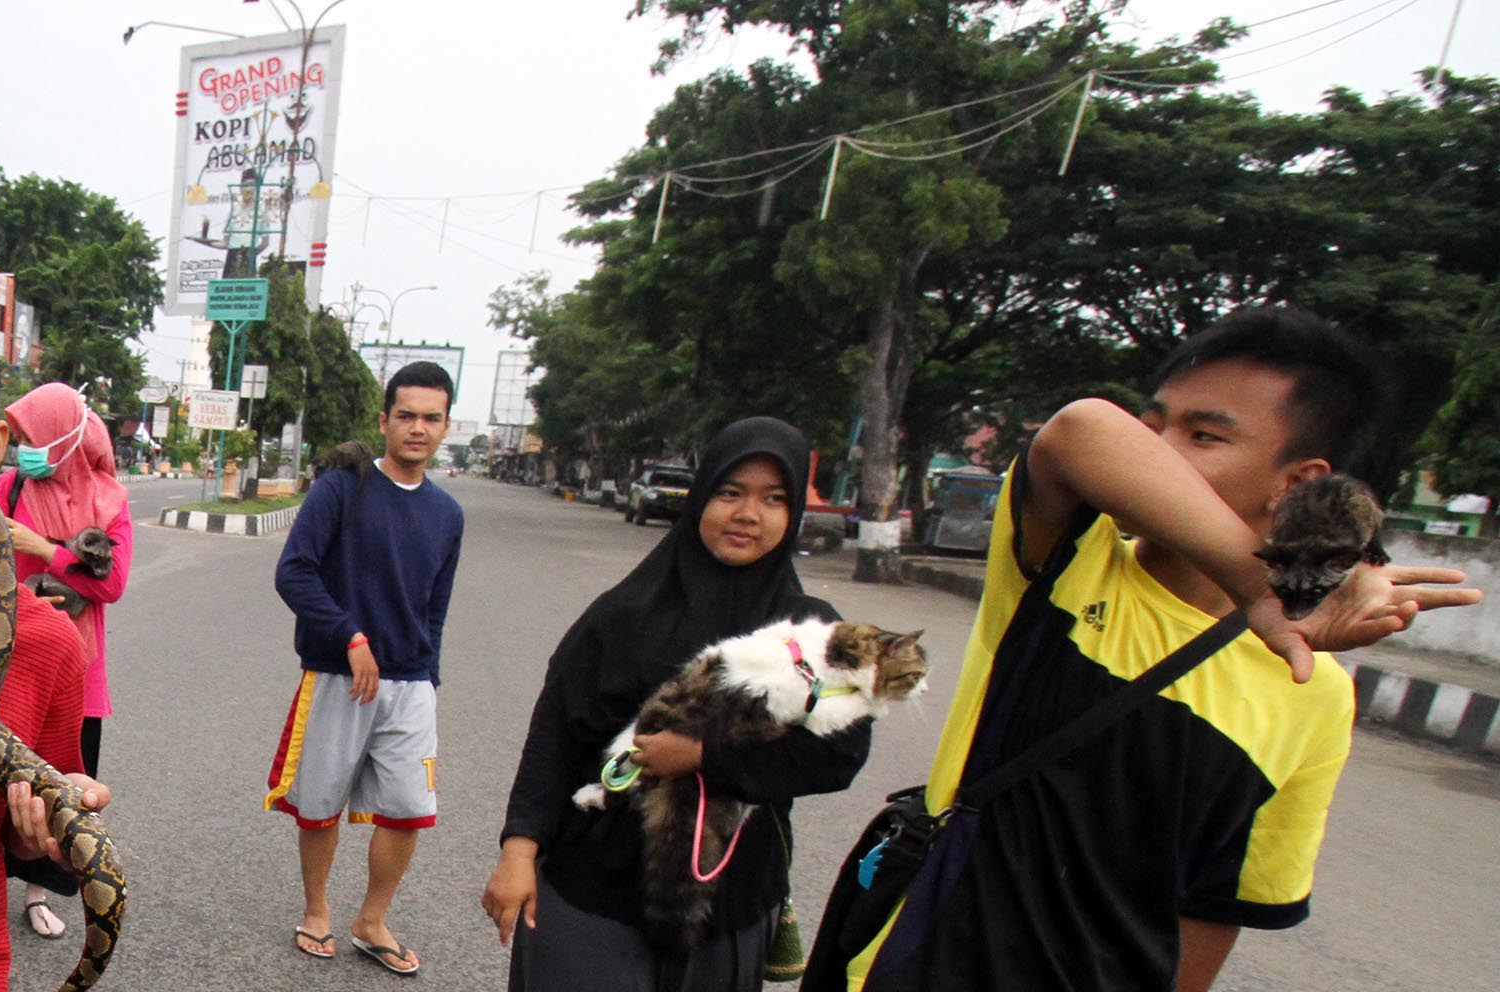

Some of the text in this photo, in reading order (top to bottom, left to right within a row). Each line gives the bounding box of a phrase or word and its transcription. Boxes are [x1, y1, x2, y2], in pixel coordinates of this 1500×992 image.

[199, 57, 282, 98] GRAND
[221, 63, 324, 112] OPENING
[195, 117, 251, 141] KOPI
[206, 144, 247, 169] ABU
